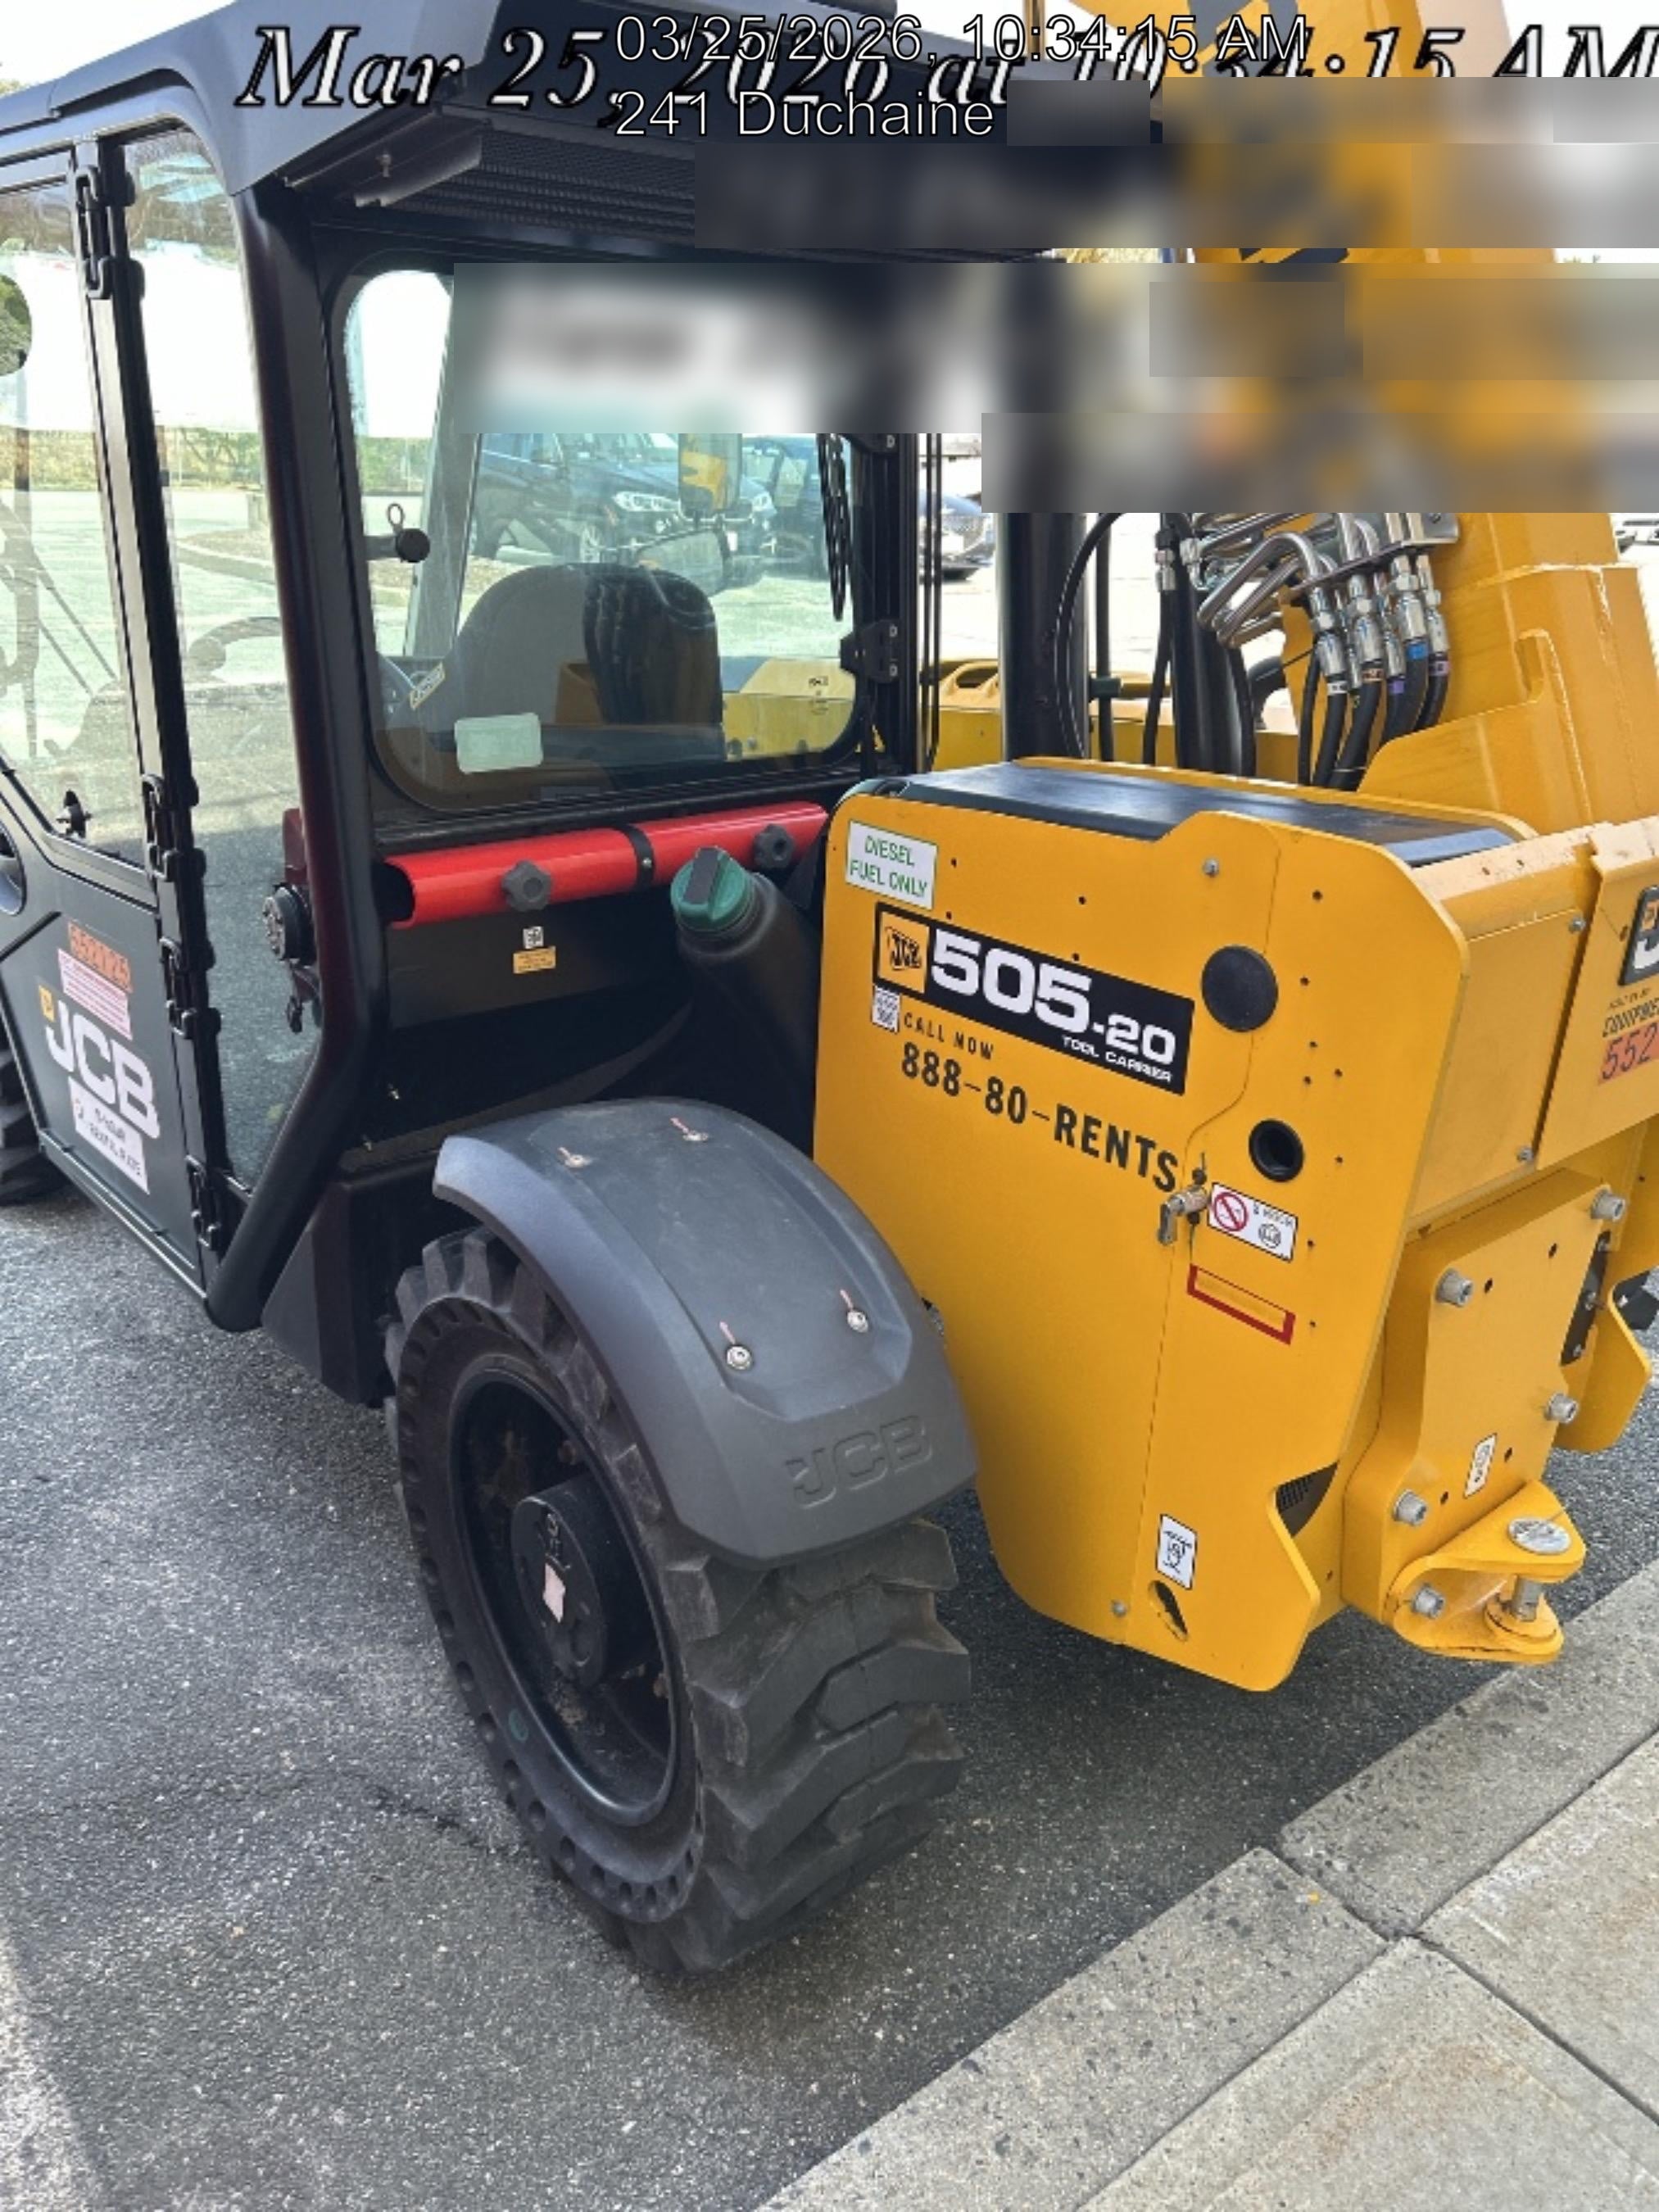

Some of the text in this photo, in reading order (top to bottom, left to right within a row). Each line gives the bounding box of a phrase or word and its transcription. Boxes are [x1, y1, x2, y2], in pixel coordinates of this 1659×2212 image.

[864, 835, 915, 867] DIESEL
[849, 859, 928, 898] FUEL ONLY
[904, 1012, 994, 1060] CALL NOW
[1063, 1034, 1100, 1058] TOOL
[45, 999, 161, 1140] JCB
[901, 1041, 1178, 1193] 888-80-RENTS
[791, 1414, 932, 1510] JCB
